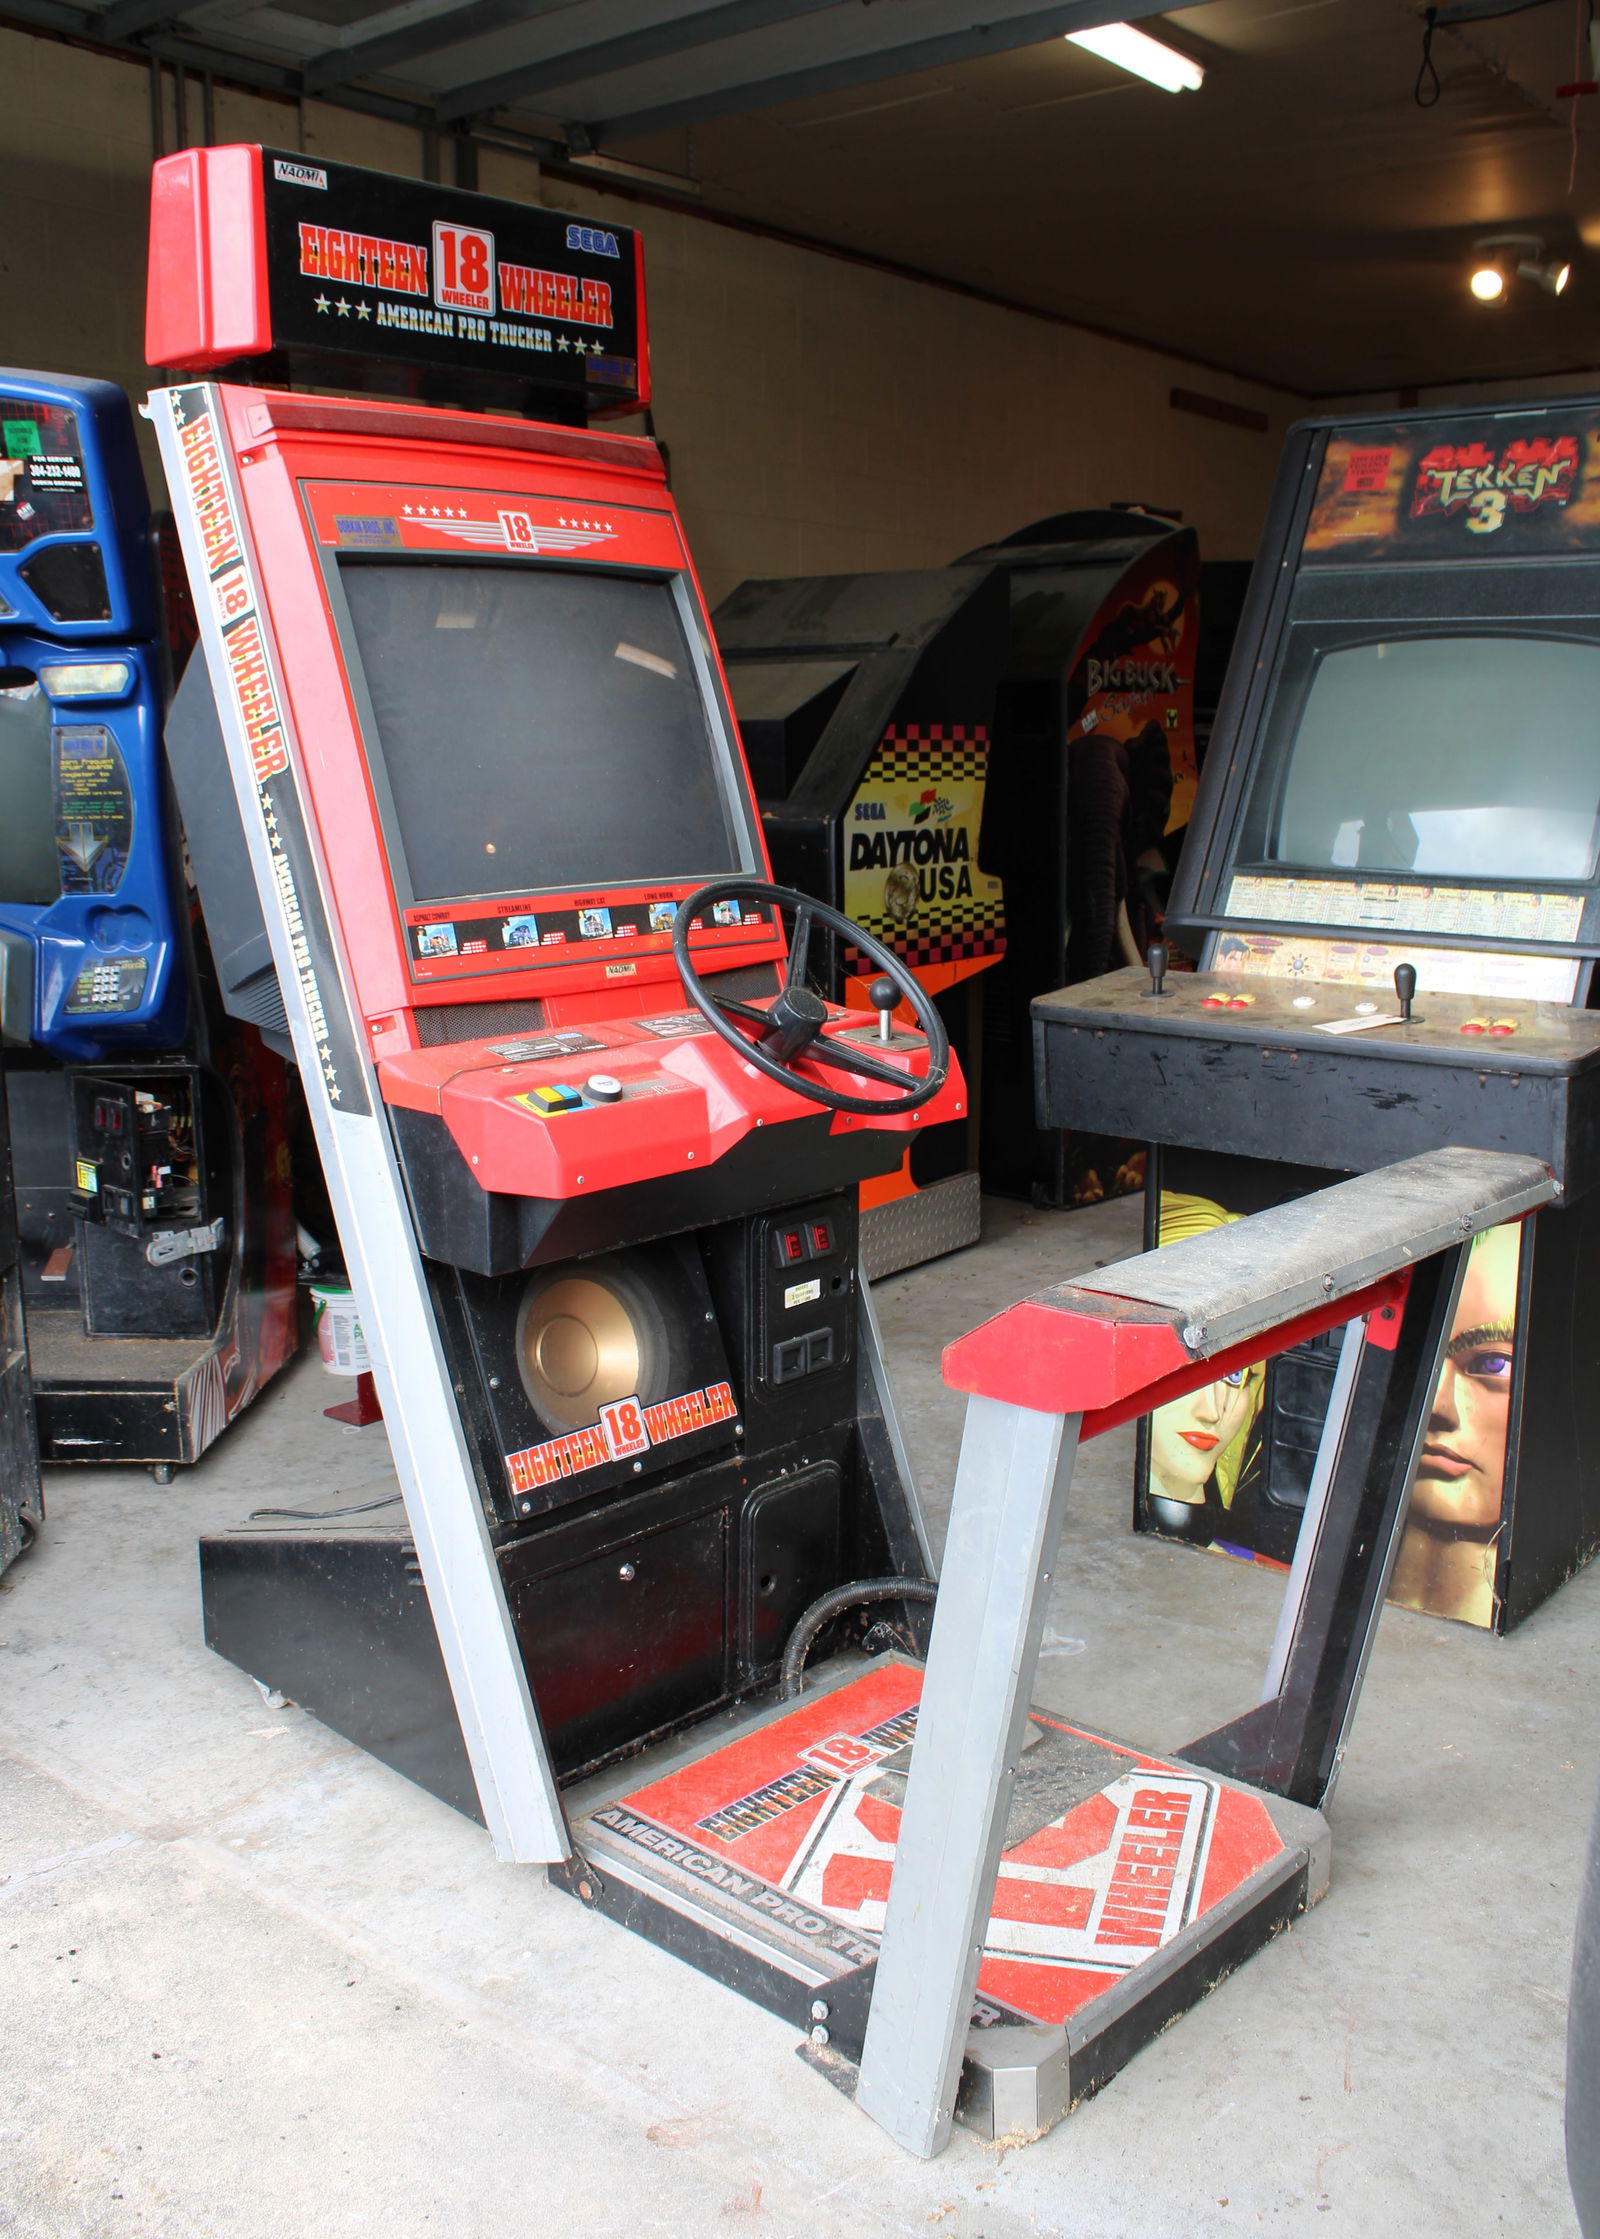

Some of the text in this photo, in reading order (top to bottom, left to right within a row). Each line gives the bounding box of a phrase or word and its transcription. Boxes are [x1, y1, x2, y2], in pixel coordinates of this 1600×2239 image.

[278, 162, 319, 182] NAOMI
[566, 224, 620, 259] SEGA
[299, 222, 614, 329] EIGHTEEN 18 WHEELER
[441, 289, 490, 311] WHEELER
[376, 302, 553, 352] AMERICAN PRO TRUCKER
[1427, 460, 1571, 506] TEKKEN
[502, 514, 532, 542] 18
[1466, 489, 1508, 534] 3
[180, 412, 290, 786] EIGHTEEN 18 WHEELER
[1087, 658, 1176, 697] BIG BUCK
[855, 803, 886, 821] SEGA
[850, 827, 970, 871] DAYTONA
[919, 865, 973, 903] USA
[497, 904, 532, 914] STREAMLINE
[273, 853, 330, 1043] AMERICAN PRO TRUCKER
[608, 965, 633, 975] NAOMI
[505, 1381, 738, 1495] EIGHTEEN 18 WHEELER
[614, 1438, 645, 1458] WHEELER
[807, 1738, 870, 1770] 18
[694, 1763, 841, 1843] EIGHTEEN
[598, 1808, 827, 1936] AMERICAN PRO
[1094, 1789, 1193, 1948] WHEELER
